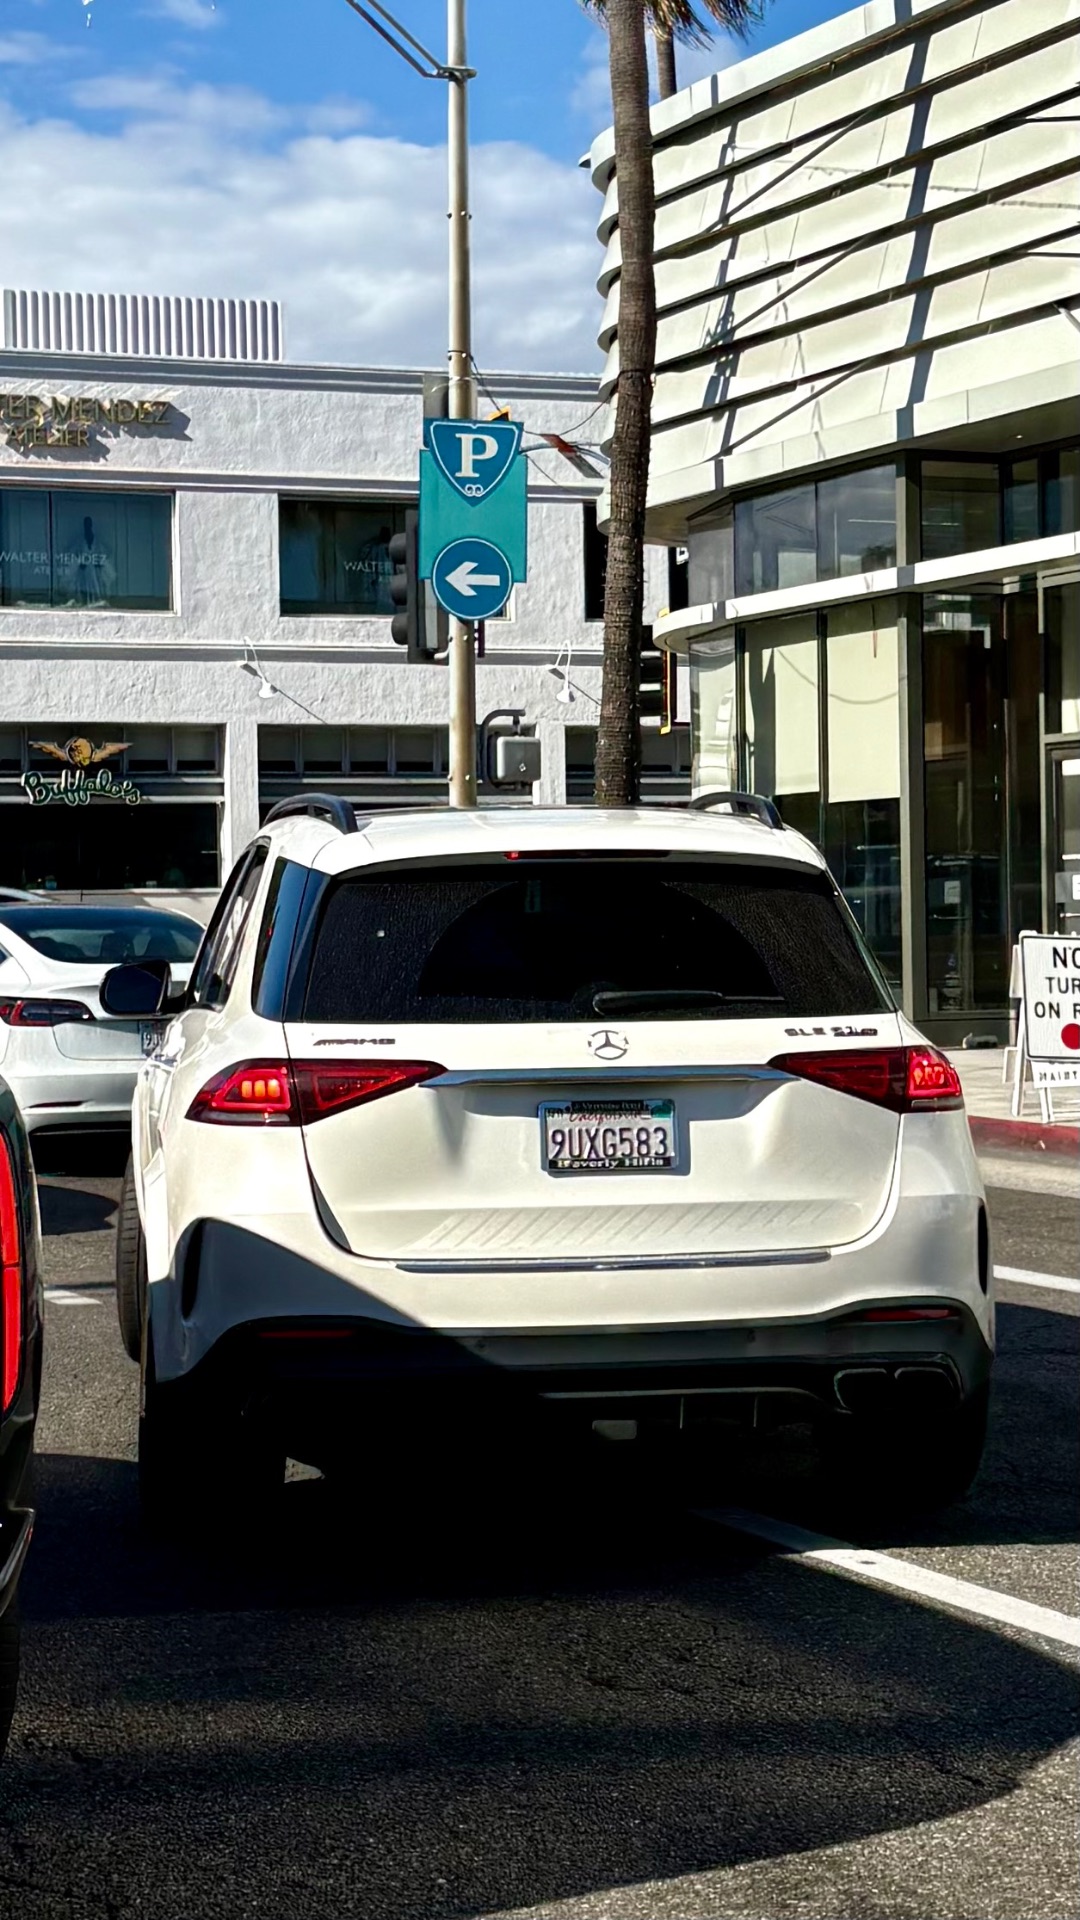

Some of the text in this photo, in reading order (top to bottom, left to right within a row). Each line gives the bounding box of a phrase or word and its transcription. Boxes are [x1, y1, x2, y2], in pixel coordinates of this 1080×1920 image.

[51, 397, 172, 425] MENDEZ
[8, 426, 90, 448] ATELIER
[454, 432, 499, 478] P
[0, 550, 107, 566] WALTER MENDEZ
[21, 768, 141, 806] Buffalo's
[1044, 976, 1080, 994] TUR
[1034, 1001, 1060, 1019] ON
[551, 1127, 668, 1159] 9UXG583
